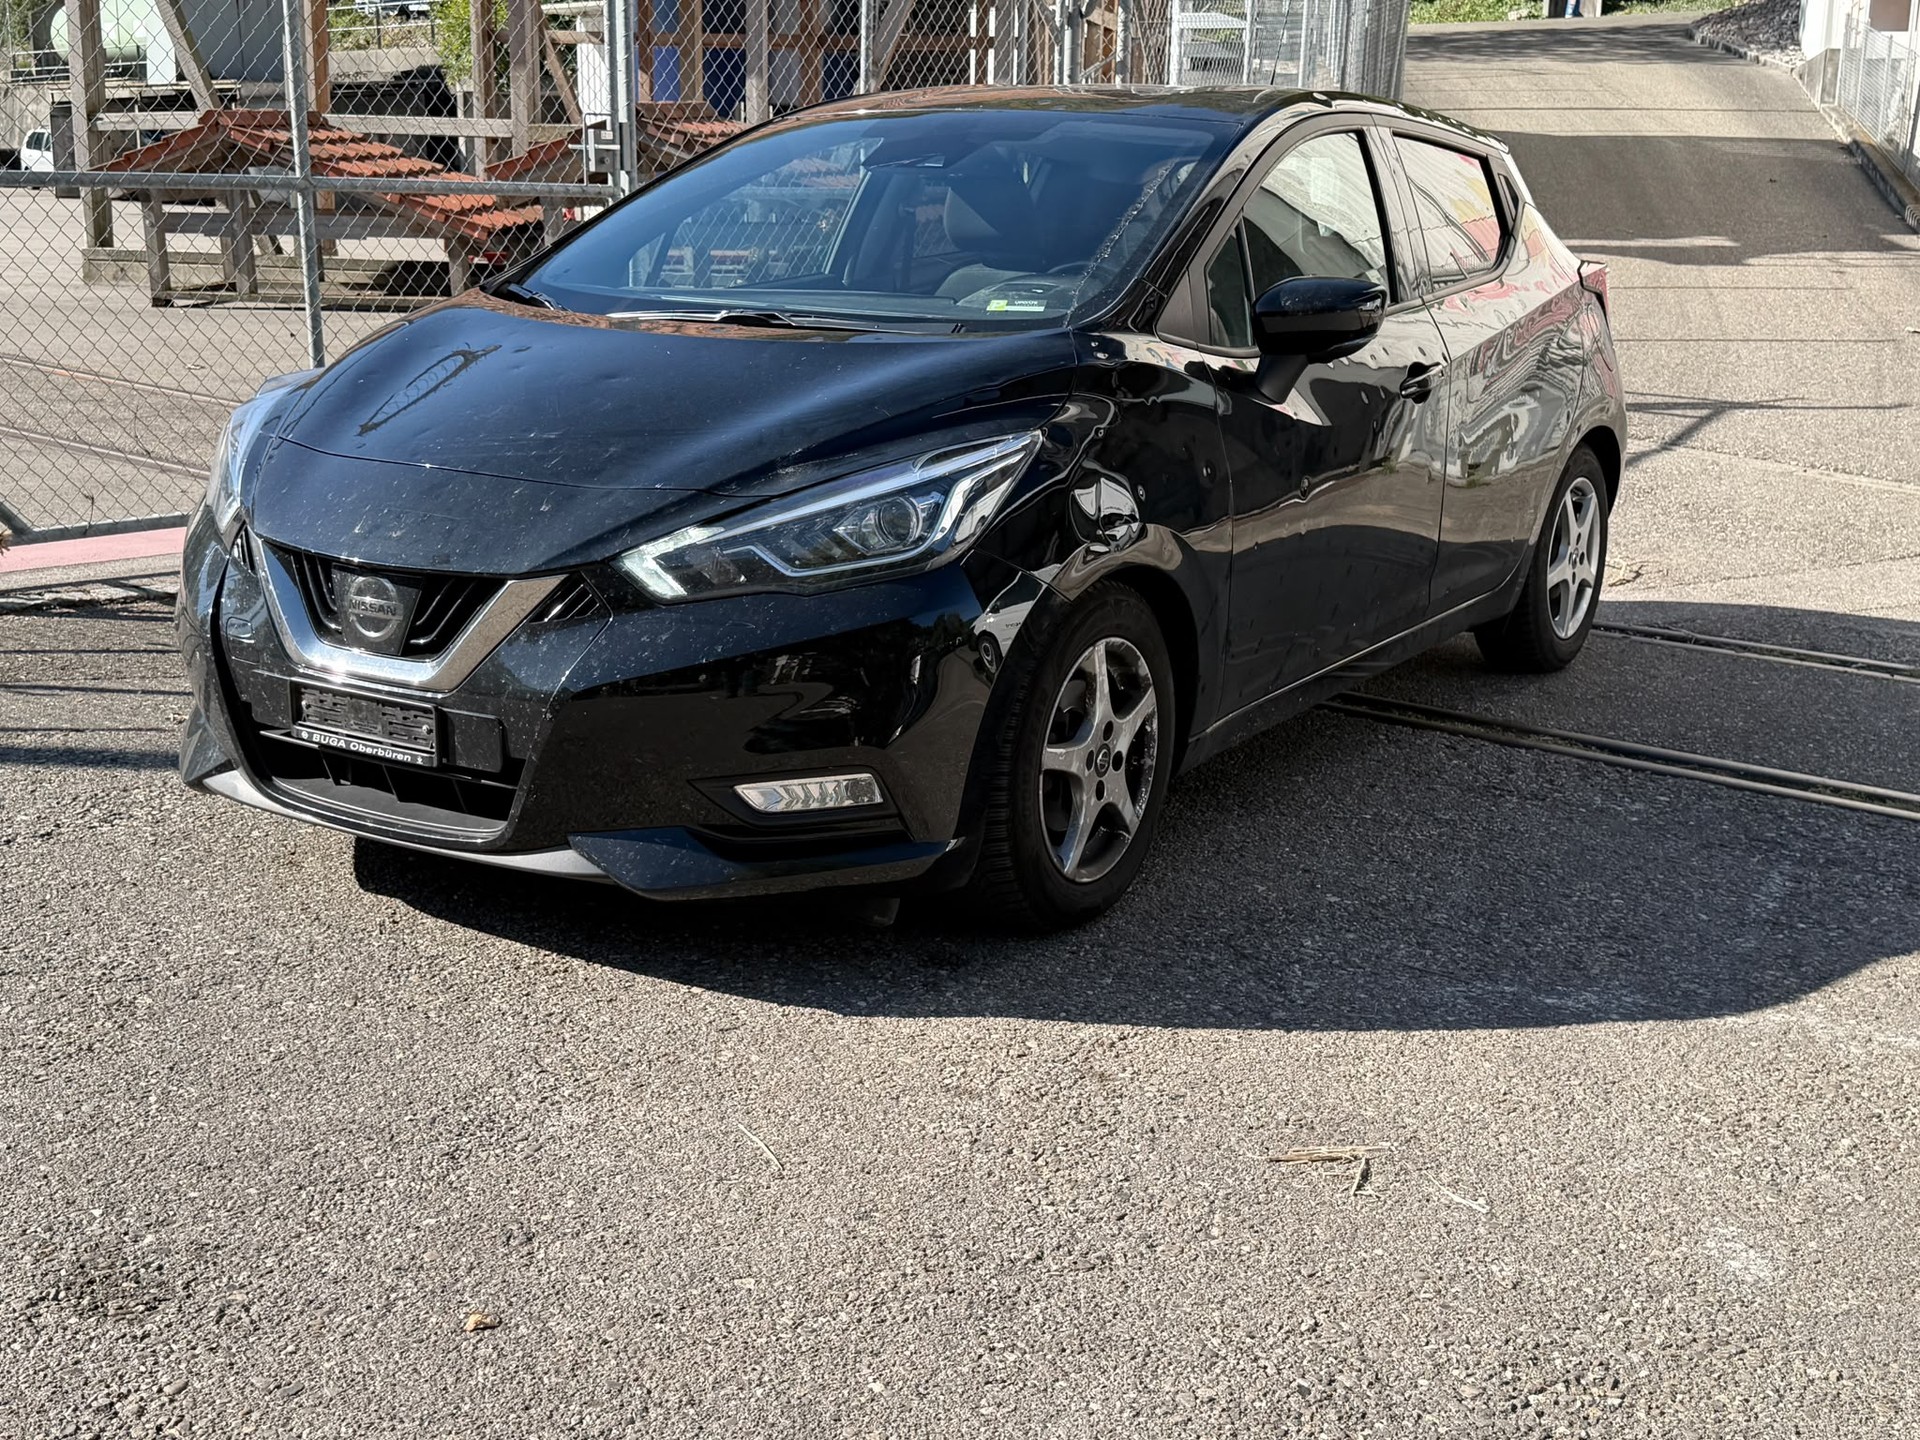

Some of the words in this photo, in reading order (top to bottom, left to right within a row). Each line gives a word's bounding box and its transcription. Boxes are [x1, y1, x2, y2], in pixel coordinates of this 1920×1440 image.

[350, 599, 397, 616] NISSAN
[312, 733, 346, 748] BUGA
[350, 741, 411, 762] Oberbüren
